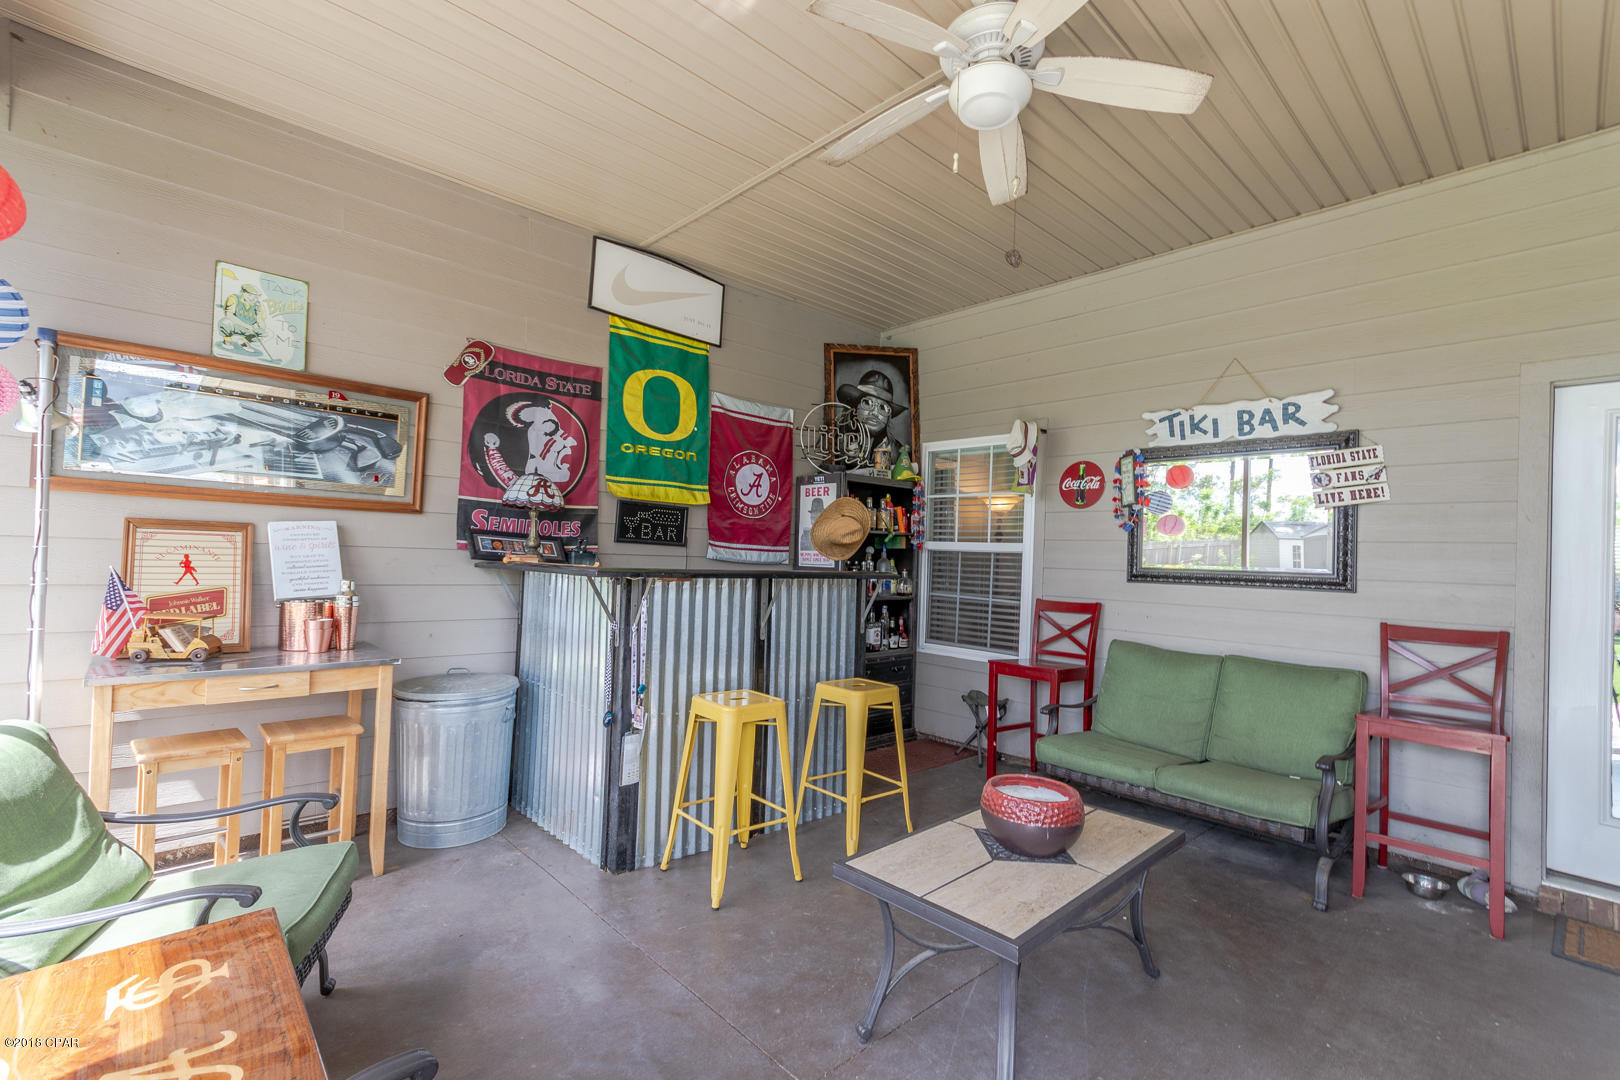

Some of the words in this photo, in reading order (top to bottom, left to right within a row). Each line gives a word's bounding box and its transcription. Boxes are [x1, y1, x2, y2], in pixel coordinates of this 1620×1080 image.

[483, 365, 543, 388] LORIDA
[545, 376, 592, 396] STATE
[331, 391, 342, 400] 19
[255, 393, 321, 409] LIGHT
[335, 405, 385, 418] GOLF
[1159, 411, 1219, 441] TIKI
[1236, 401, 1308, 437] BAR
[620, 442, 697, 462] OREGON
[1309, 454, 1347, 468] FLORIDA
[1349, 447, 1378, 462] STATE
[729, 454, 777, 483] ALABAMA
[1336, 469, 1365, 483] FANS
[804, 486, 830, 498] BEER
[1062, 476, 1102, 490] Coca-Cola
[728, 487, 759, 515] CRIMSON
[760, 492, 776, 512] TIDE
[1317, 493, 1345, 505] LIVE
[1350, 486, 1386, 501] HERE!
[641, 523, 677, 541] BAR
[179, 601, 221, 616] LABEL
[191, 595, 211, 604] Walker
